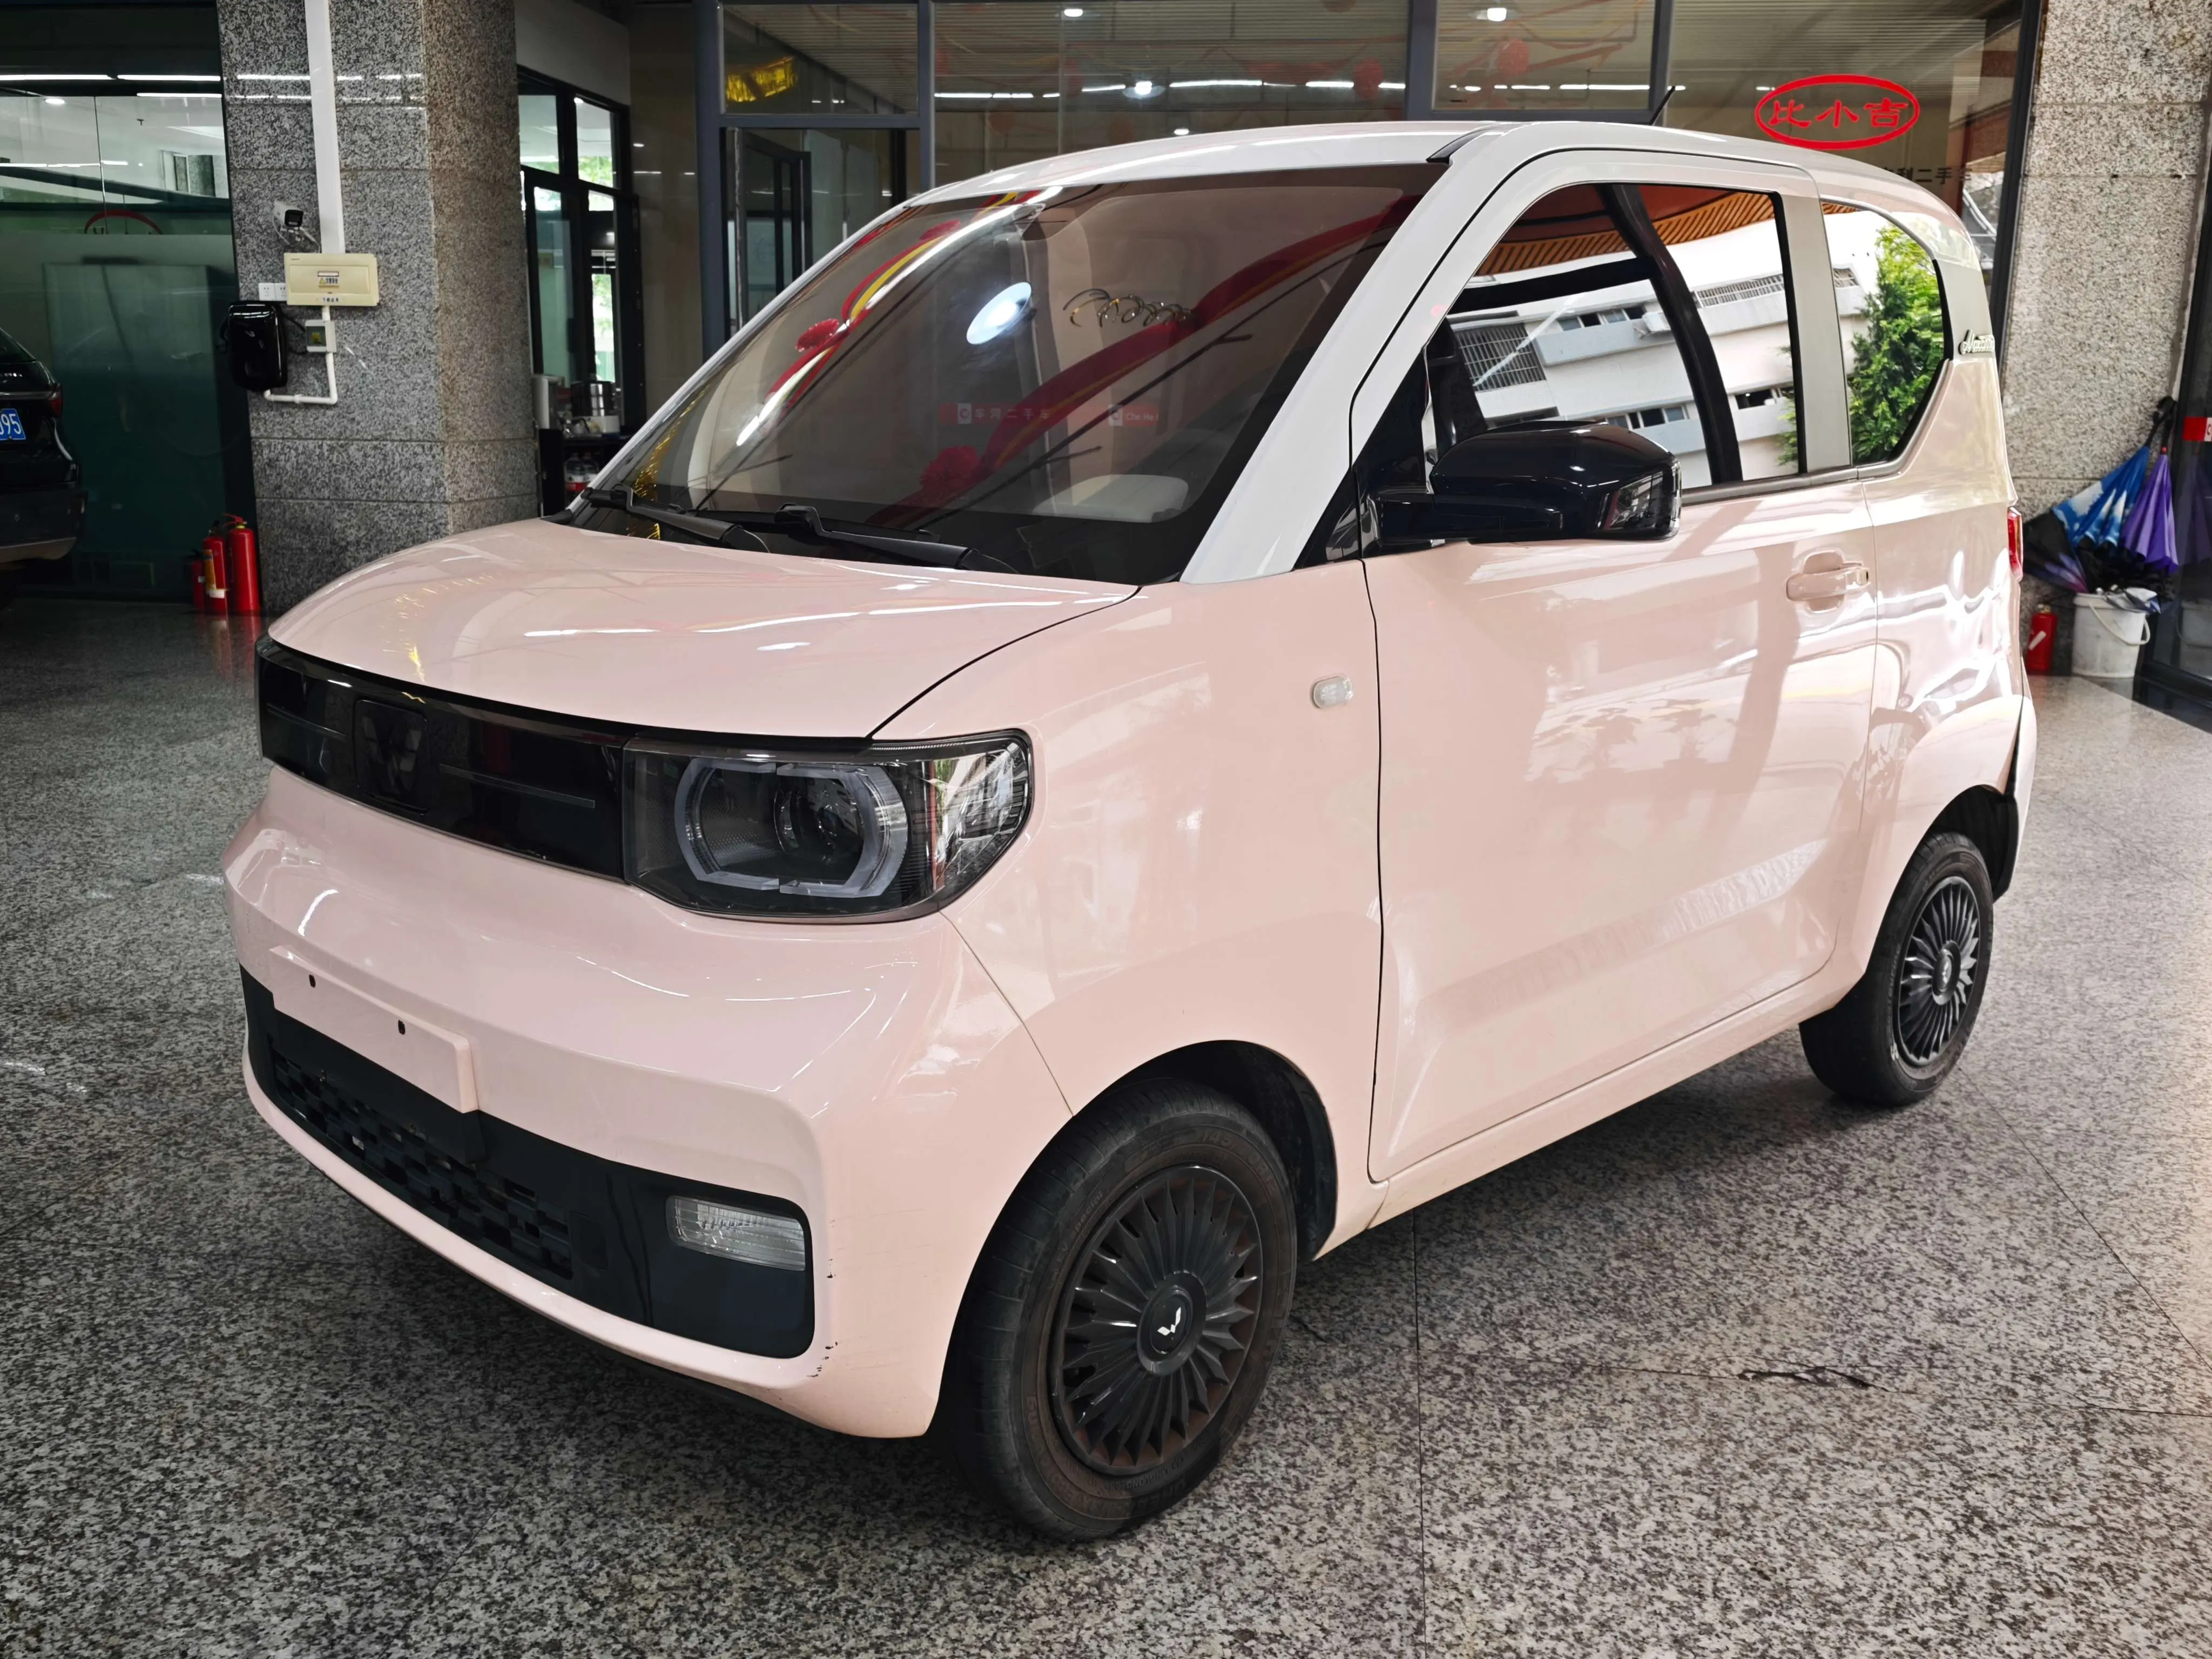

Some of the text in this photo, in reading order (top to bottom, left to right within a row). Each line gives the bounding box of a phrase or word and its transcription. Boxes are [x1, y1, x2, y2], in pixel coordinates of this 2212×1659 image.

[1768, 97, 1909, 128] 比小吉
[1884, 167, 1973, 185] 利二手车
[0, 413, 21, 435] 95
